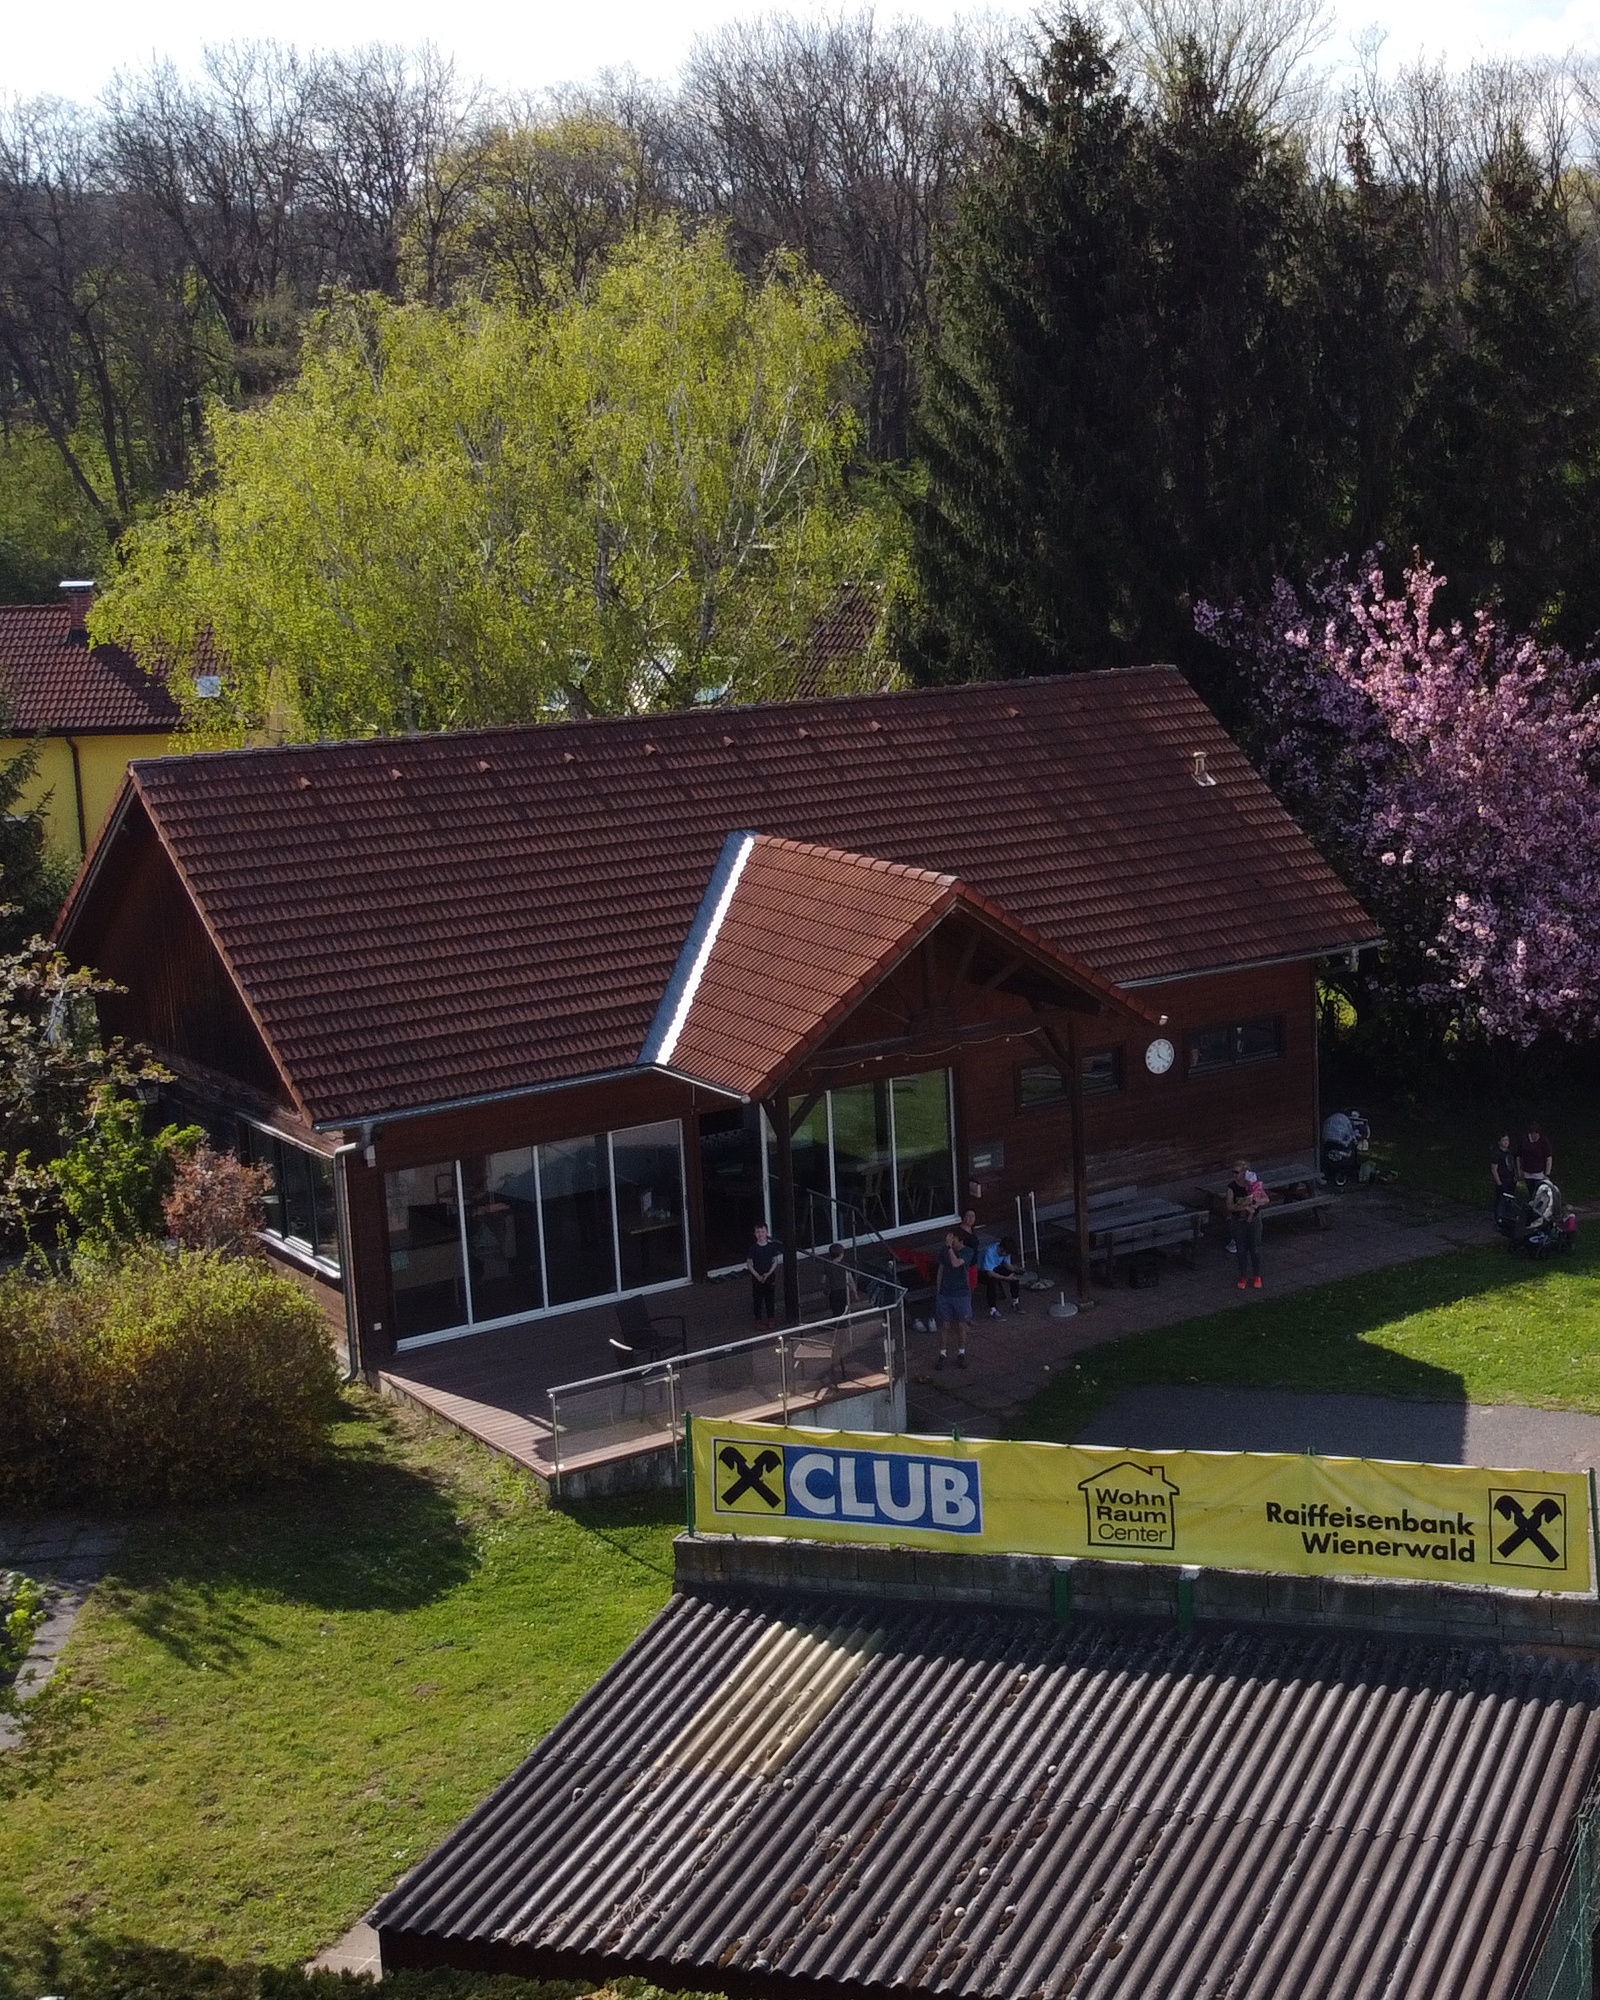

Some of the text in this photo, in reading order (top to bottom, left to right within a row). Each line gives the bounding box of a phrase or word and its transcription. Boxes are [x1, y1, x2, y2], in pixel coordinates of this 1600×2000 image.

[789, 1453, 976, 1526] CLUB
[1096, 1488, 1165, 1506] Wohn
[1096, 1506, 1166, 1524] Raum
[1266, 1502, 1475, 1536] Raiffeisenbank
[1098, 1523, 1167, 1542] Center
[1301, 1531, 1475, 1562] Wienerwald
